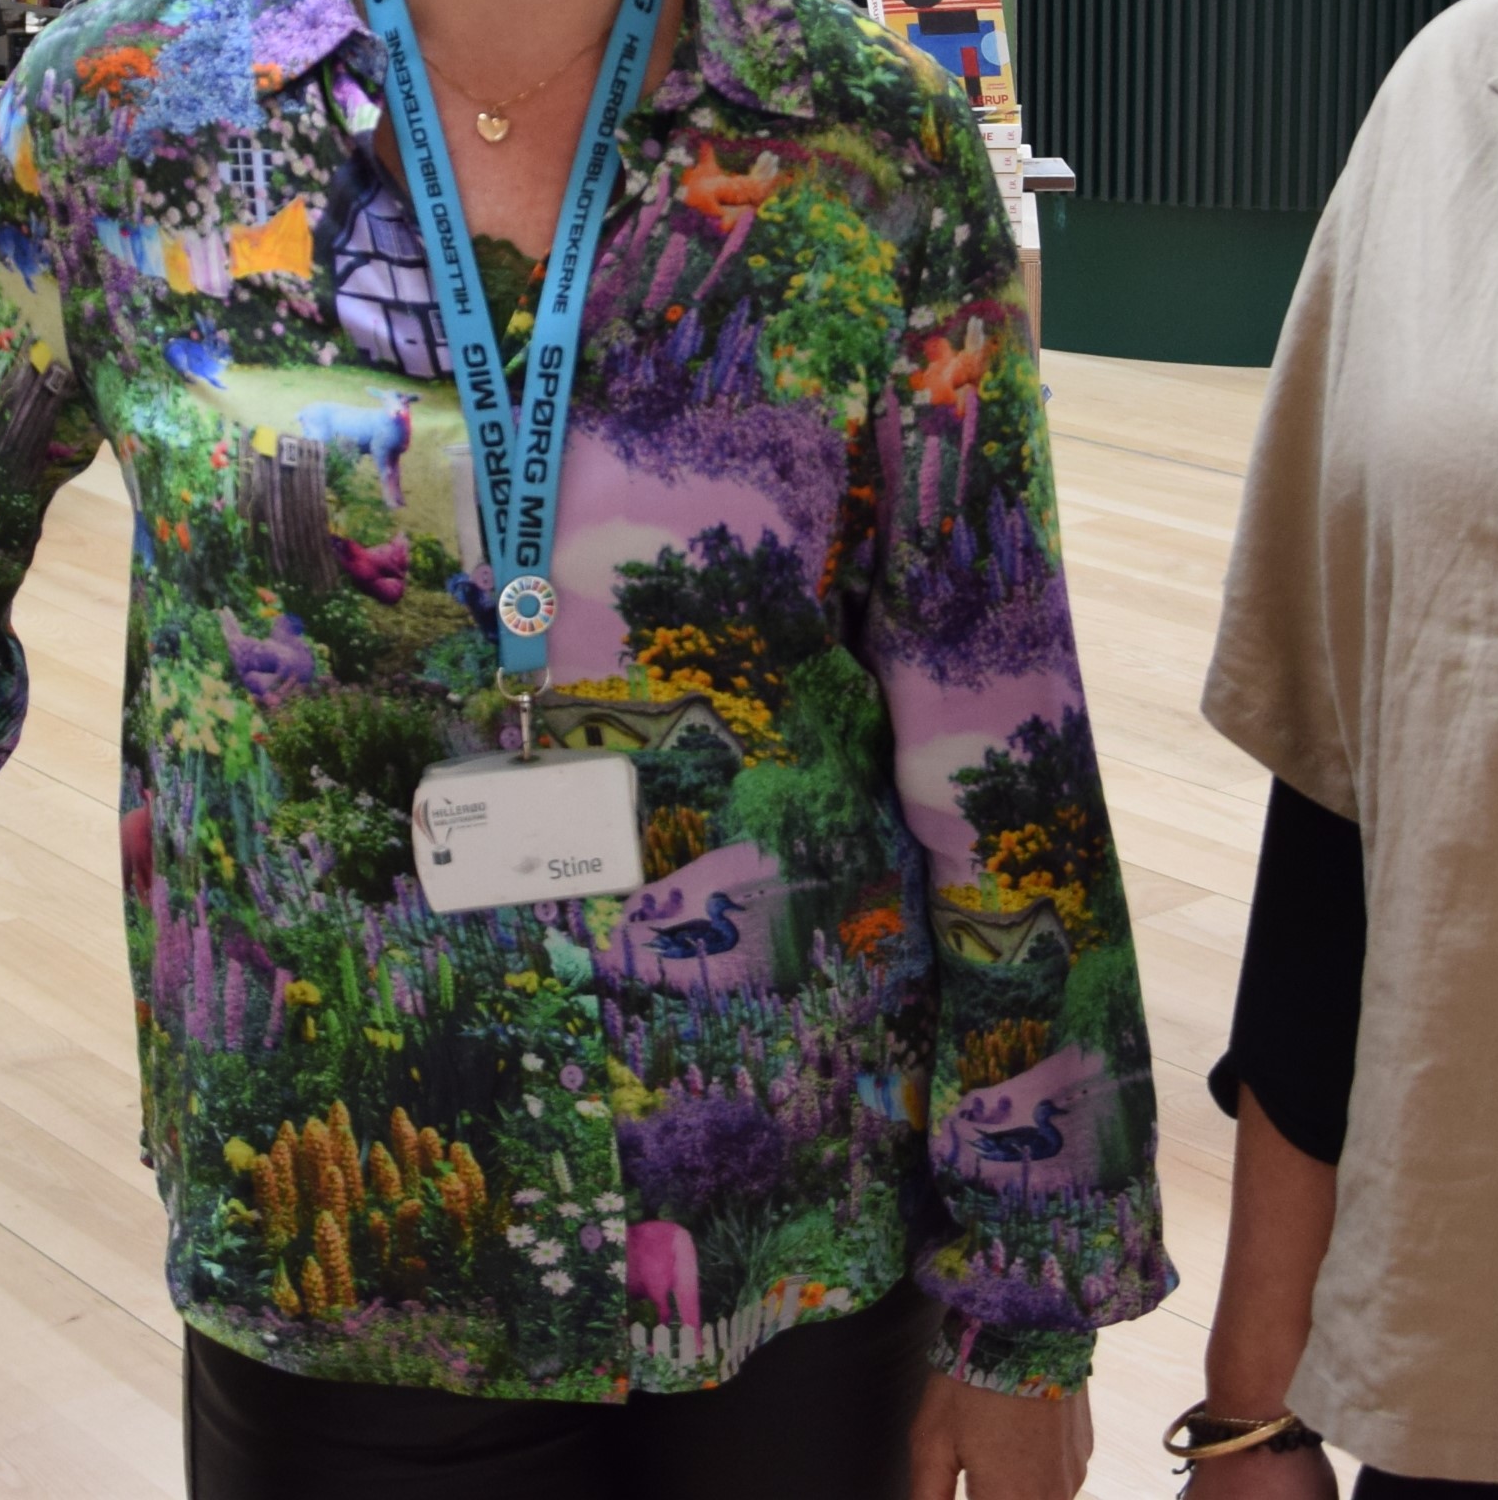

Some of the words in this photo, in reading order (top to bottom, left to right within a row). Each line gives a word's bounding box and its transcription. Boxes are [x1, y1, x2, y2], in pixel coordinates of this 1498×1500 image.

[384, 27, 443, 199] BIBLIOTEKERNE
[601, 32, 640, 138] HILLERØD
[431, 201, 473, 315] HILLERØD
[552, 137, 614, 315] BIBLIOTEKERNE
[463, 342, 496, 413] MIG
[522, 344, 564, 485] SPØRG
[516, 495, 545, 568] MIG
[432, 801, 487, 819] HILLERØD
[547, 855, 603, 880] Stine
